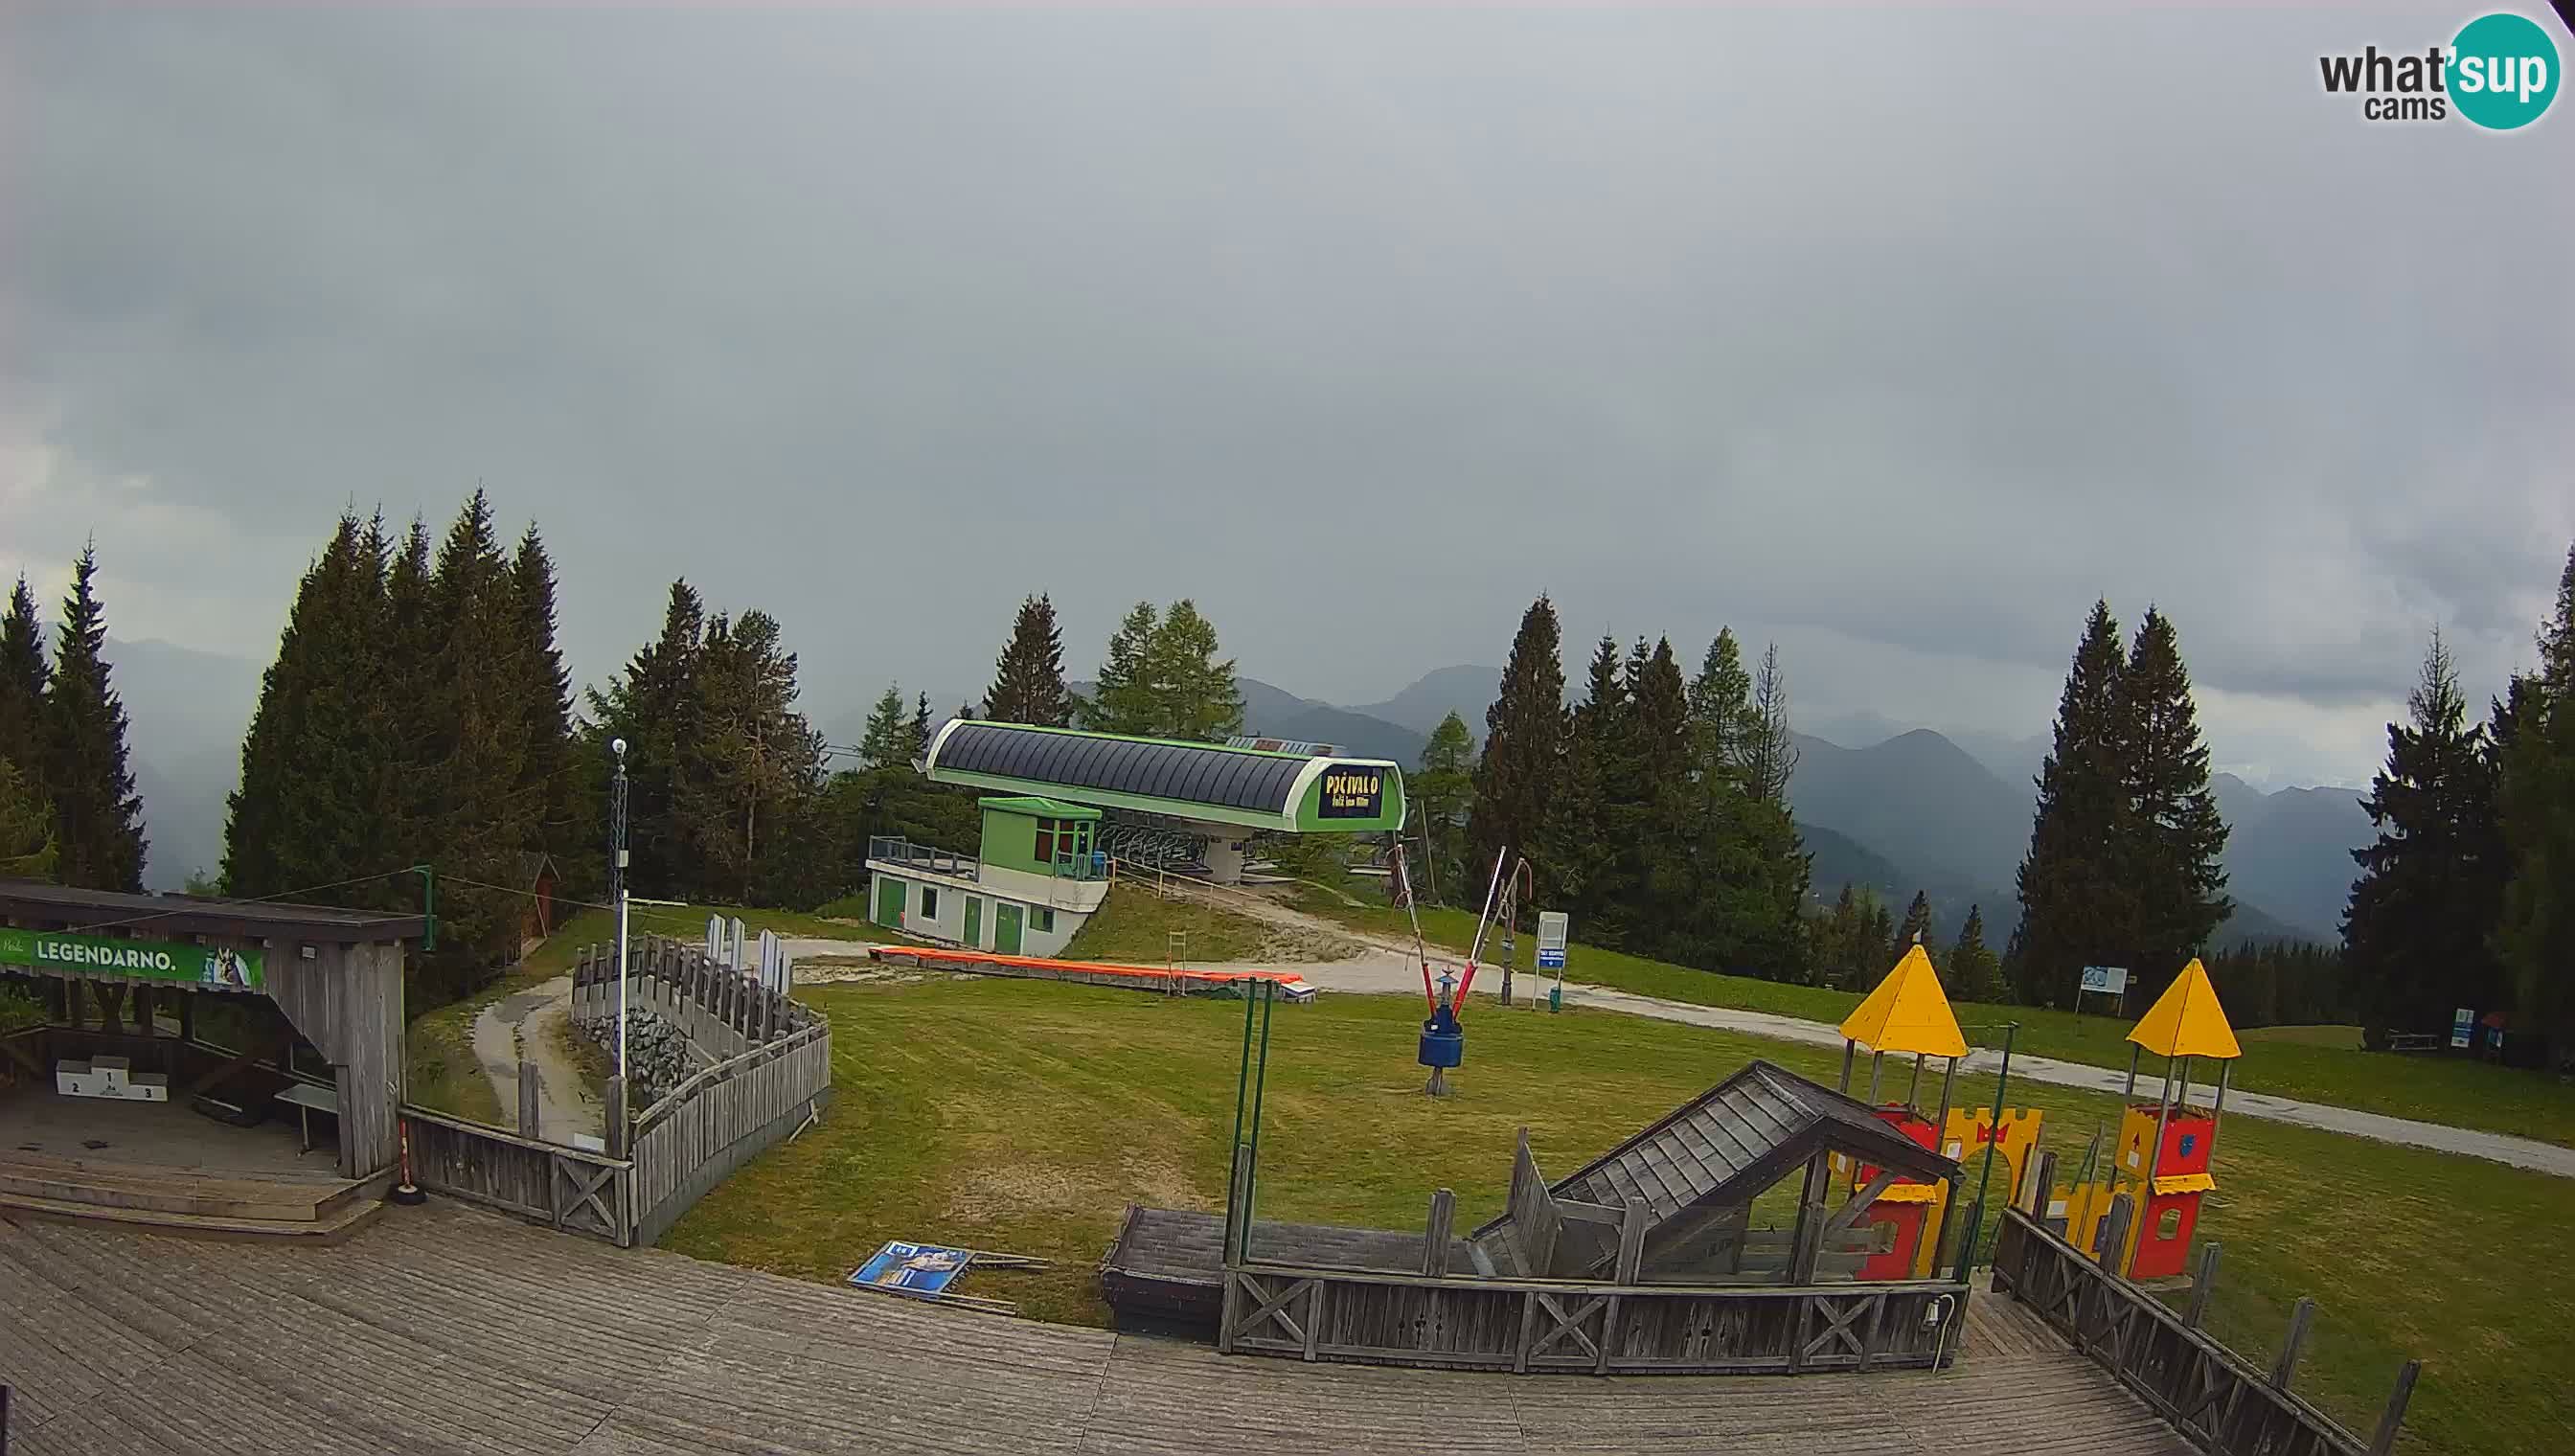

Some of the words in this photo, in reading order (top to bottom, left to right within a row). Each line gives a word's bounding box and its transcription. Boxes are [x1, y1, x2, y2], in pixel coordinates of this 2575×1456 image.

[36, 940, 177, 971] LEGENDARNO.
[106, 1072, 112, 1082] 1
[72, 1082, 80, 1093] 2
[145, 1088, 152, 1098] 3
